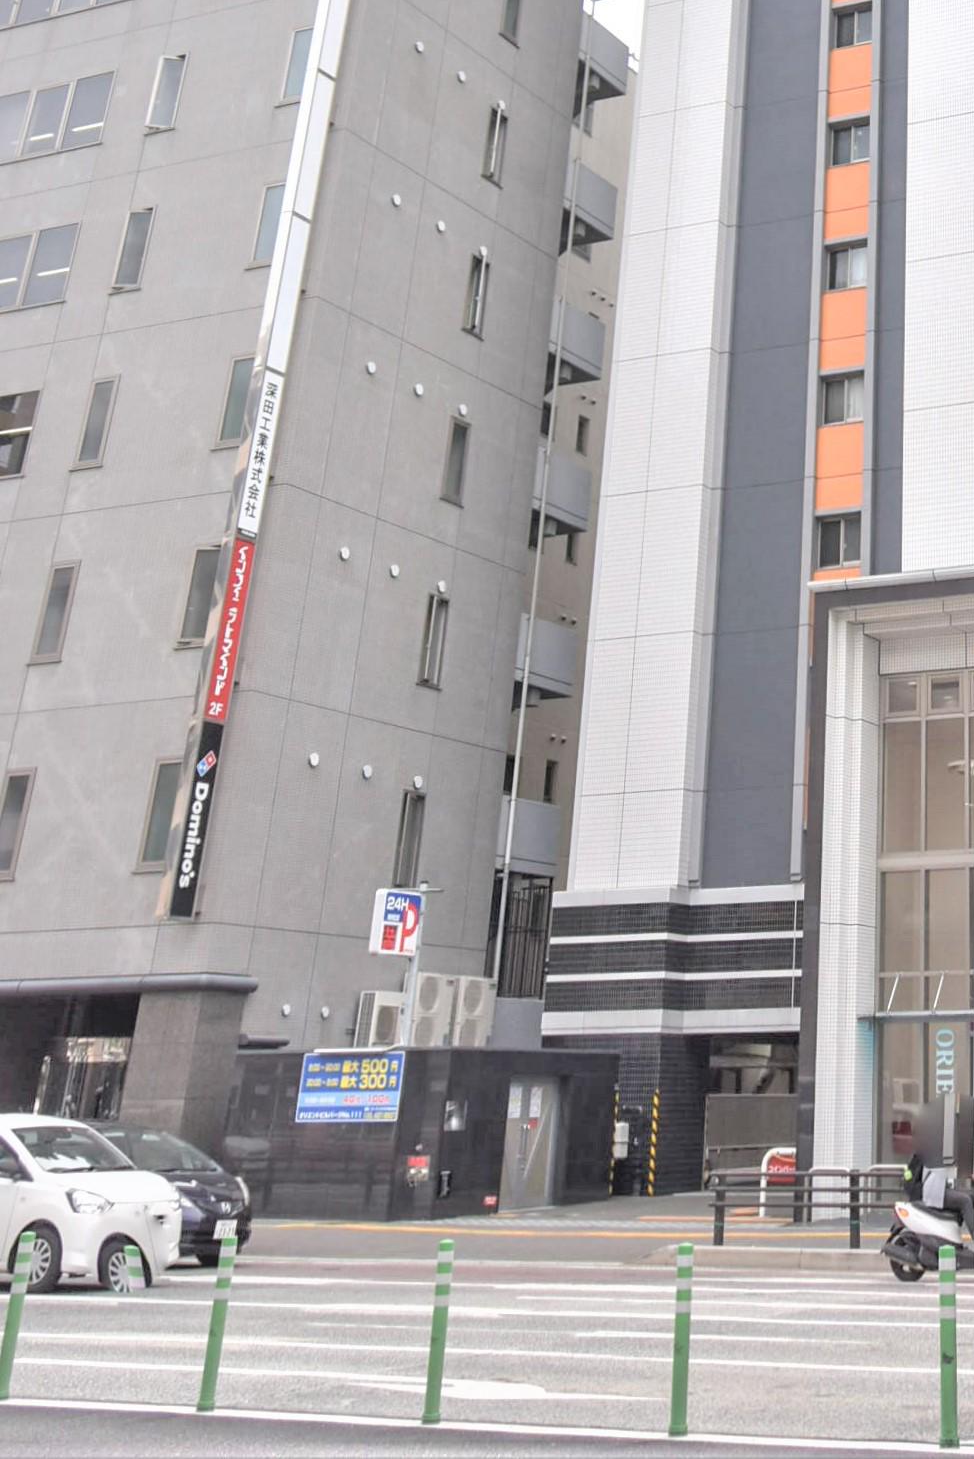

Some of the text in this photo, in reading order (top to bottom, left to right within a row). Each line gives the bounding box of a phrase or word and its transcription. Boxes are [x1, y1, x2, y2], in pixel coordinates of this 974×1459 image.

[208, 701, 224, 717] 2F
[179, 781, 209, 889] Domino's
[386, 895, 409, 912] 24H
